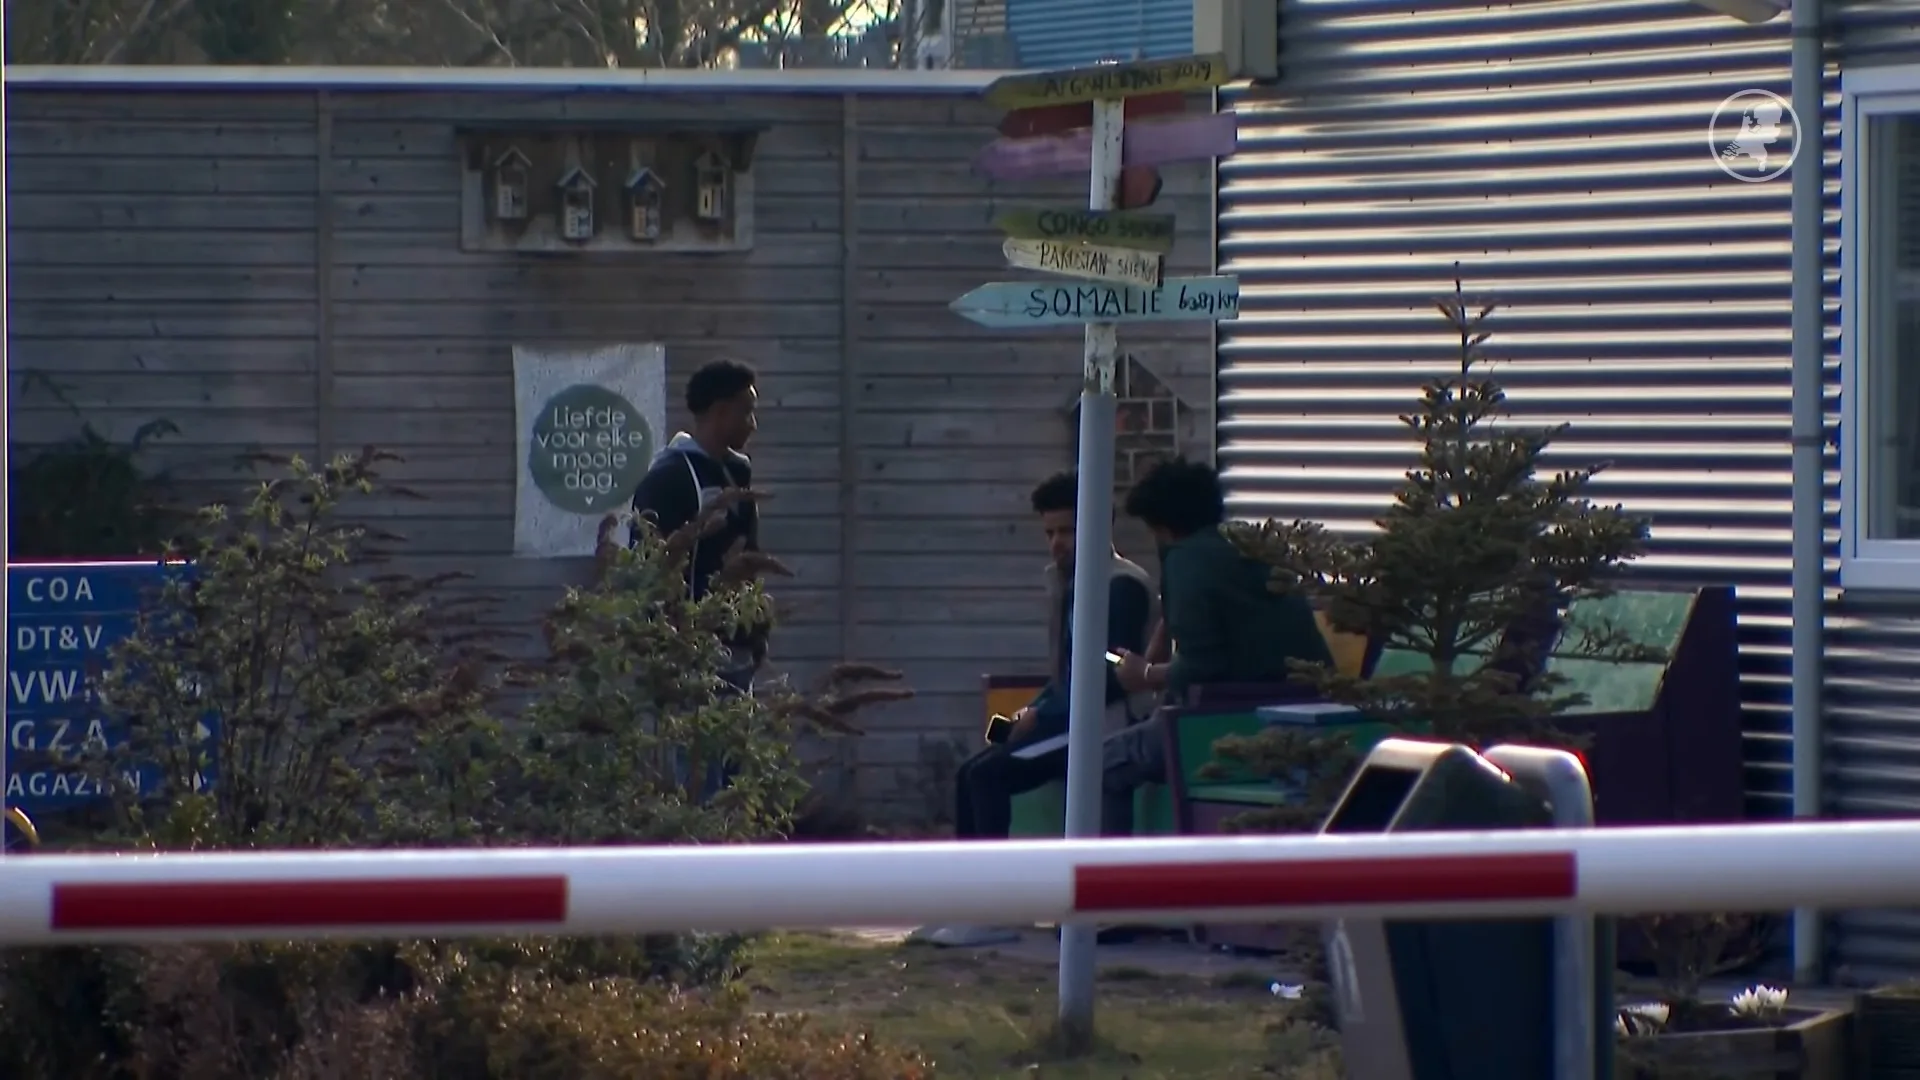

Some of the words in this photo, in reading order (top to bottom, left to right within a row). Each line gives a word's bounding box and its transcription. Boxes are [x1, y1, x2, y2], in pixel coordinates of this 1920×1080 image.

[1039, 241, 1107, 276] PAKISTAN
[1030, 288, 1162, 317] SOMALIE
[554, 406, 626, 428] Liefde
[537, 431, 590, 449] voor
[596, 427, 643, 448] elke
[553, 448, 628, 470] mooie
[564, 469, 618, 494] dag.
[26, 577, 94, 601] COA
[17, 625, 103, 651] DT&V
[11, 719, 108, 752] GZA
